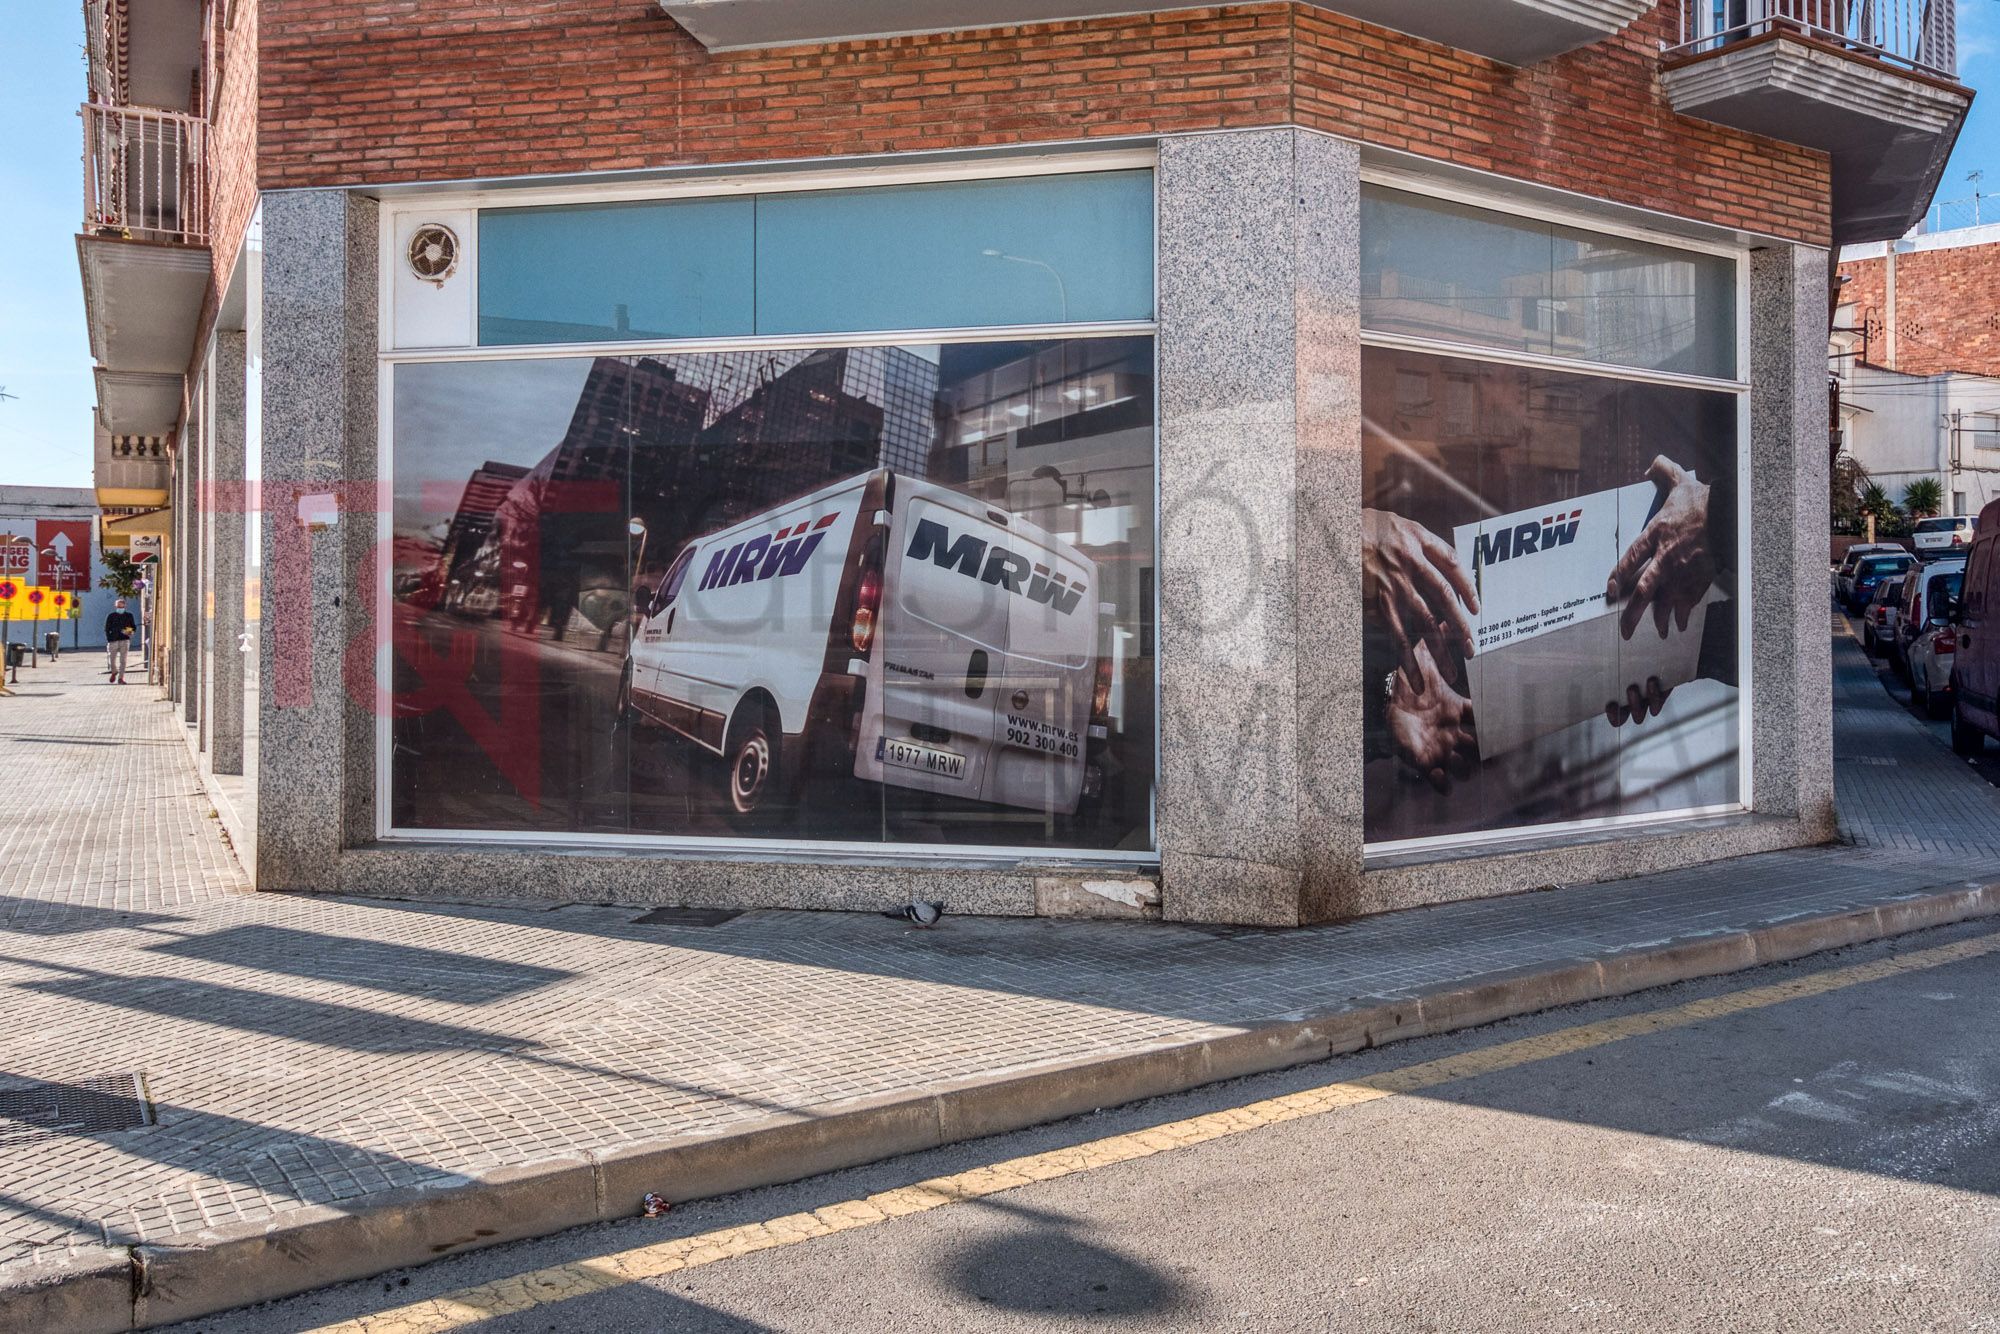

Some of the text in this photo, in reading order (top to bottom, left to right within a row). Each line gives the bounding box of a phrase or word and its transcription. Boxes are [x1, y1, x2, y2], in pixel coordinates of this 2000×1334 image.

[698, 511, 841, 592] MRW
[1471, 508, 1583, 570] MRW
[905, 517, 1087, 616] MRW
[1489, 623, 1499, 633] 300
[1501, 619, 1511, 629] 400
[1516, 613, 1537, 624] Andorra
[1541, 606, 1559, 617] España
[1563, 597, 1585, 610] Gibraltar
[1490, 633, 1500, 644] 236
[1502, 630, 1512, 640] 333
[1517, 622, 1539, 636] Portugal
[1543, 612, 1575, 627] www.mrw.pt
[1007, 714, 1079, 742] www.mrw.es
[1007, 728, 1079, 757] 902 300 400
[888, 743, 961, 775] 1977 MRW
